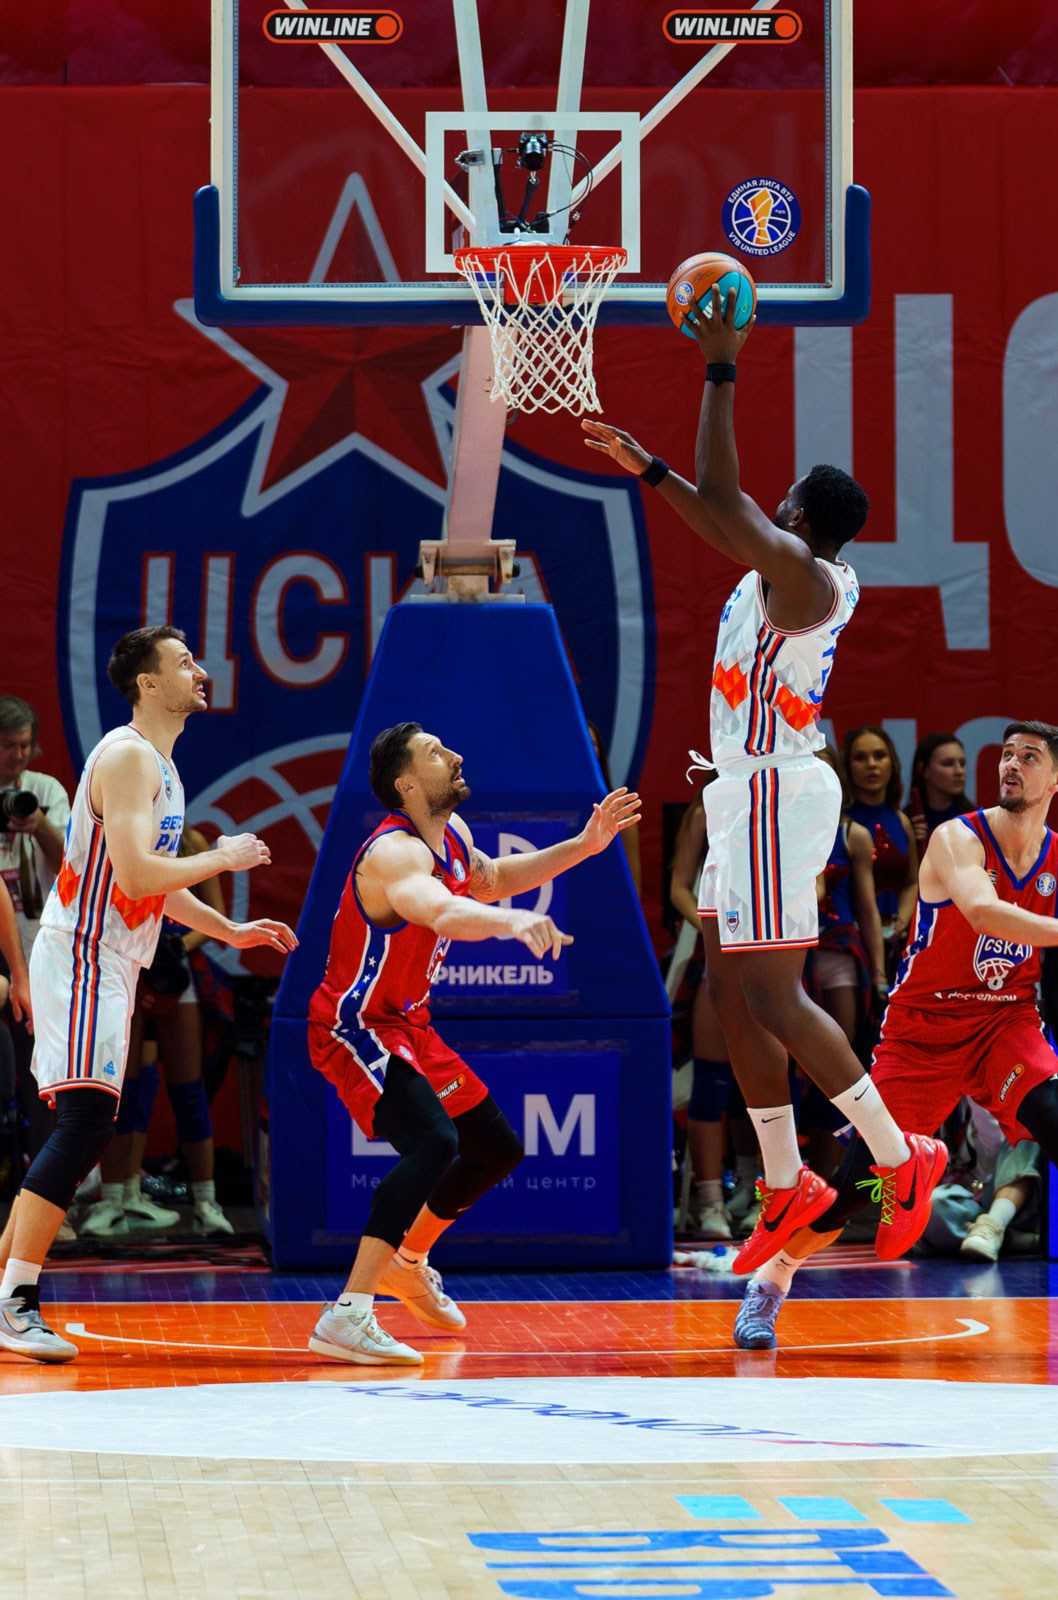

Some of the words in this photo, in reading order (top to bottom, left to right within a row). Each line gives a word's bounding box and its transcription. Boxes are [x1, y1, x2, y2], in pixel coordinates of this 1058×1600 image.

[275, 17, 372, 36] WINLINE
[674, 17, 771, 36] WINLINE
[727, 180, 758, 204] ЕДИНАЯ
[759, 179, 781, 191] ЛИГА
[780, 187, 795, 202] ВТБ
[728, 231, 742, 247] VTB
[740, 243, 769, 256] UNITED
[769, 230, 796, 254] LEAGUE
[984, 938, 1024, 958] CSKA
[526, 1175, 597, 1191] центр
